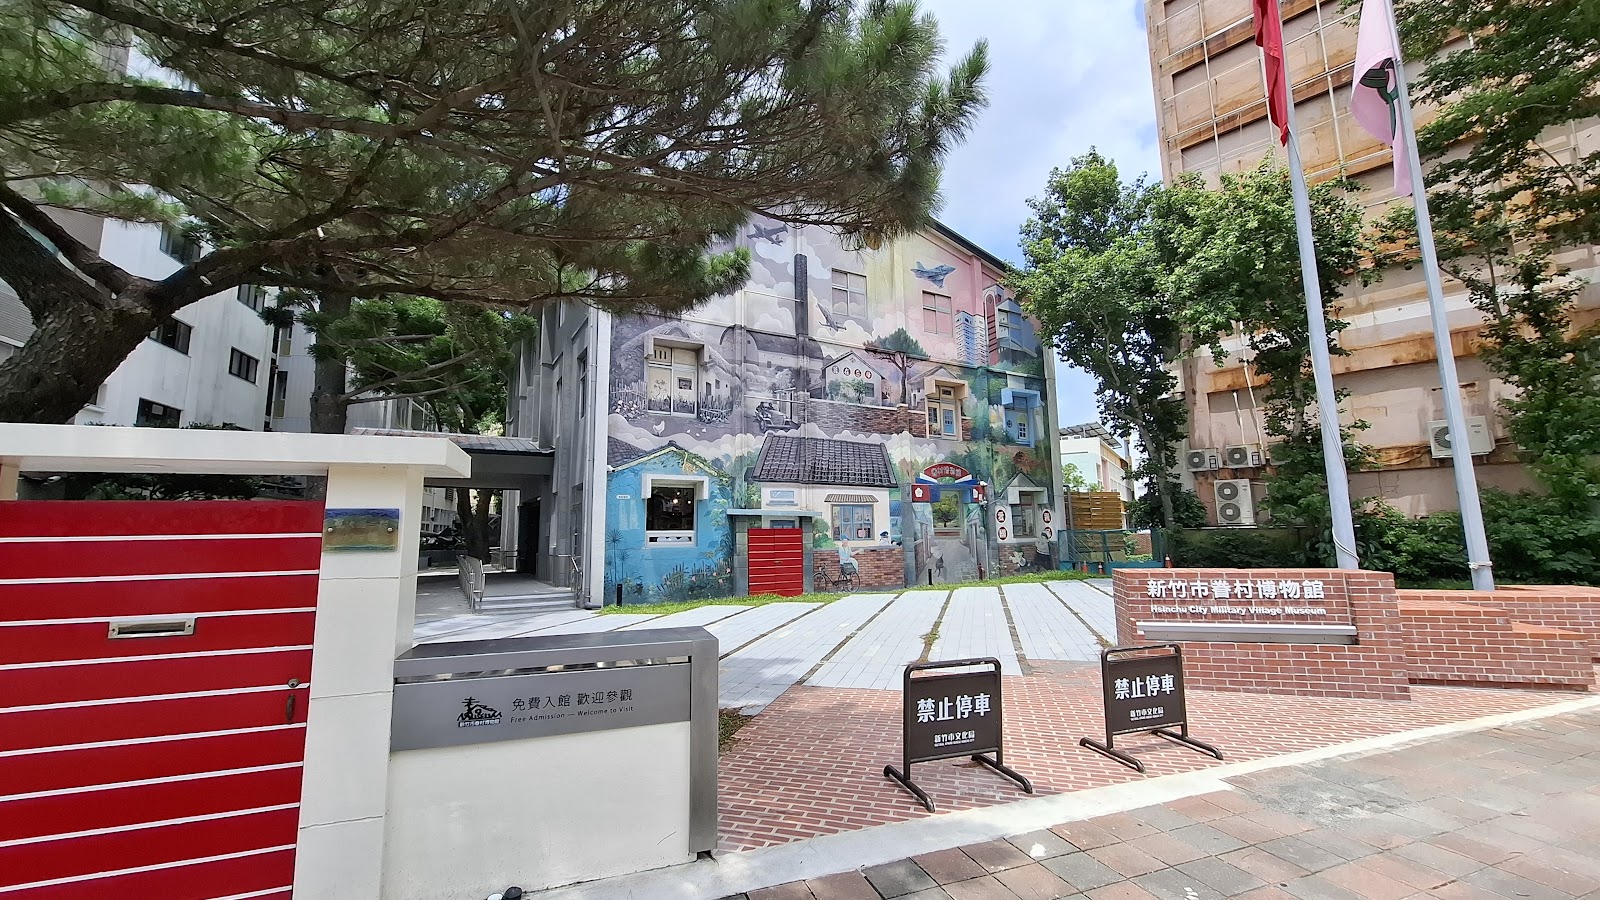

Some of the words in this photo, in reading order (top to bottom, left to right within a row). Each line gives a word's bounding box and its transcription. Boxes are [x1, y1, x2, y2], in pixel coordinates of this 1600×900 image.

[1147, 579, 1325, 599] 新竹市眷村博物館
[1150, 605, 1187, 613] Hsinchu
[1189, 605, 1208, 615] City
[1210, 606, 1246, 615] Military
[1248, 606, 1282, 616] Village
[1285, 606, 1327, 615] Museum
[1114, 673, 1175, 700] 禁止停車
[512, 694, 571, 712] 免費入館
[576, 688, 633, 706] 歡迎參觀
[916, 692, 991, 723] 禁止停車
[528, 713, 565, 721] Admission
[577, 709, 608, 717] Welcome
